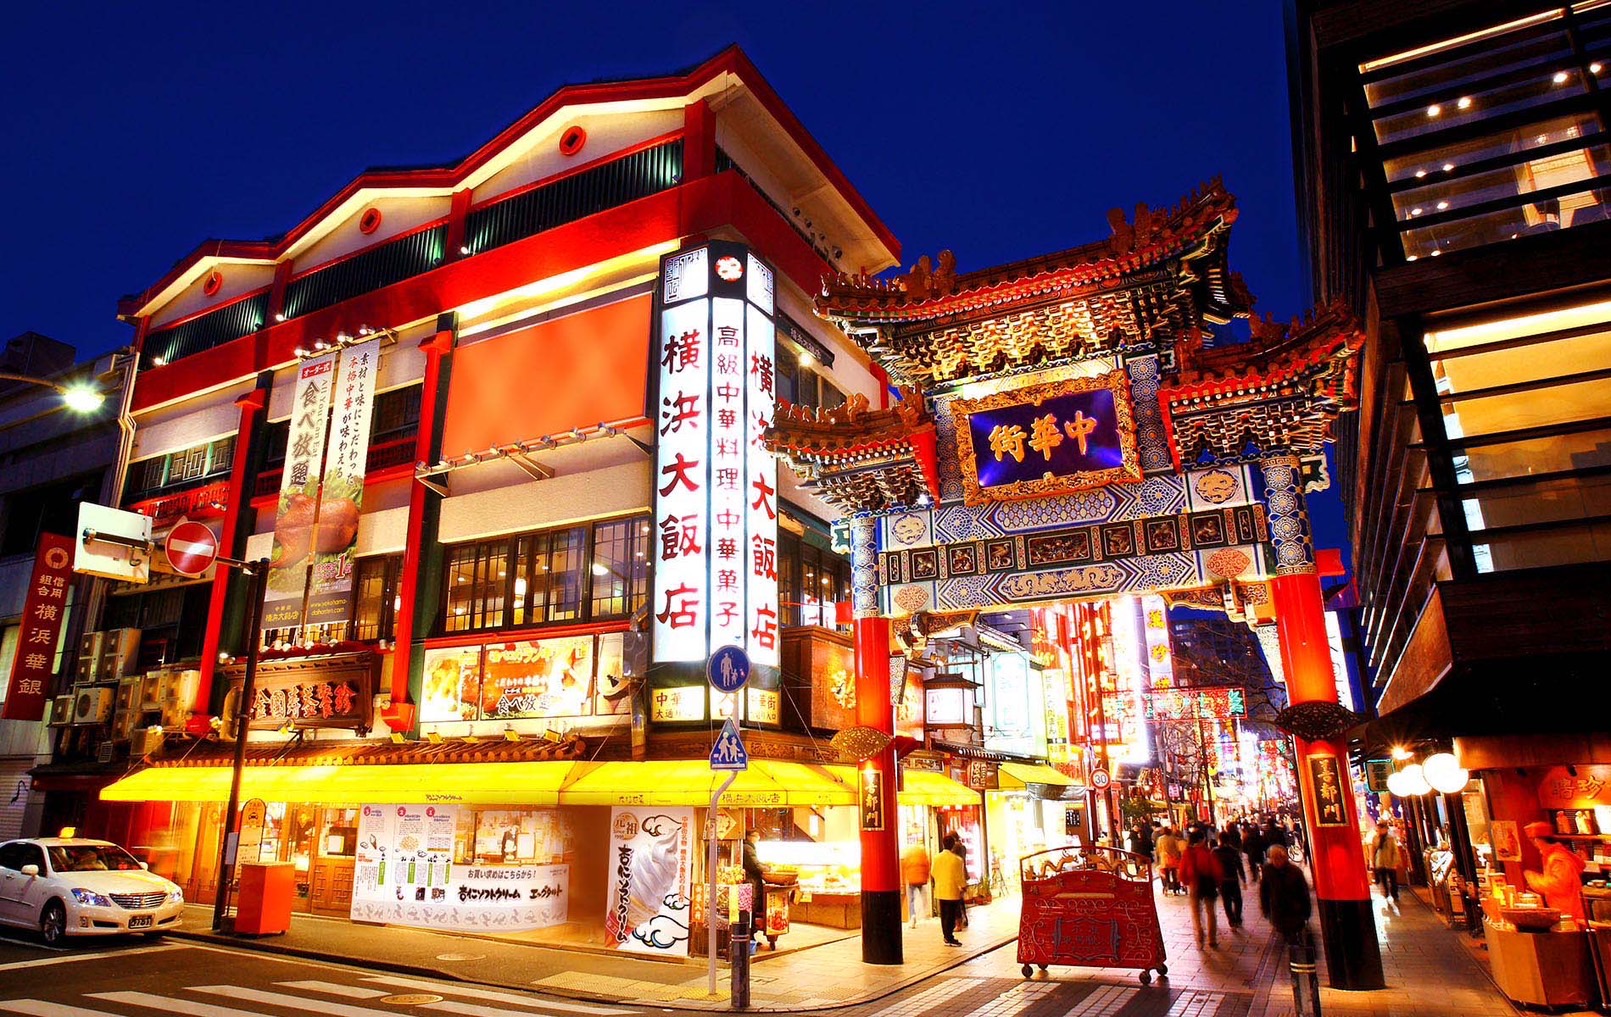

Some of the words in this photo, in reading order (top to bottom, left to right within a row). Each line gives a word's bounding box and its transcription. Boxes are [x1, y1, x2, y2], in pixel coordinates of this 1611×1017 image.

[289, 380, 320, 486] 食べ放題
[336, 356, 359, 478] 本格中華が味わえる
[346, 353, 370, 485] 素材と味にこだわった
[656, 329, 702, 630] 横浜大飯店
[18, 603, 58, 695] 横浜華銀
[1094, 774, 1107, 784] 30
[458, 884, 521, 901] 杏仁ソフトクリーム
[529, 882, 563, 900] エッグタルト
[617, 844, 633, 942] 杏仁ソフトクリーム
